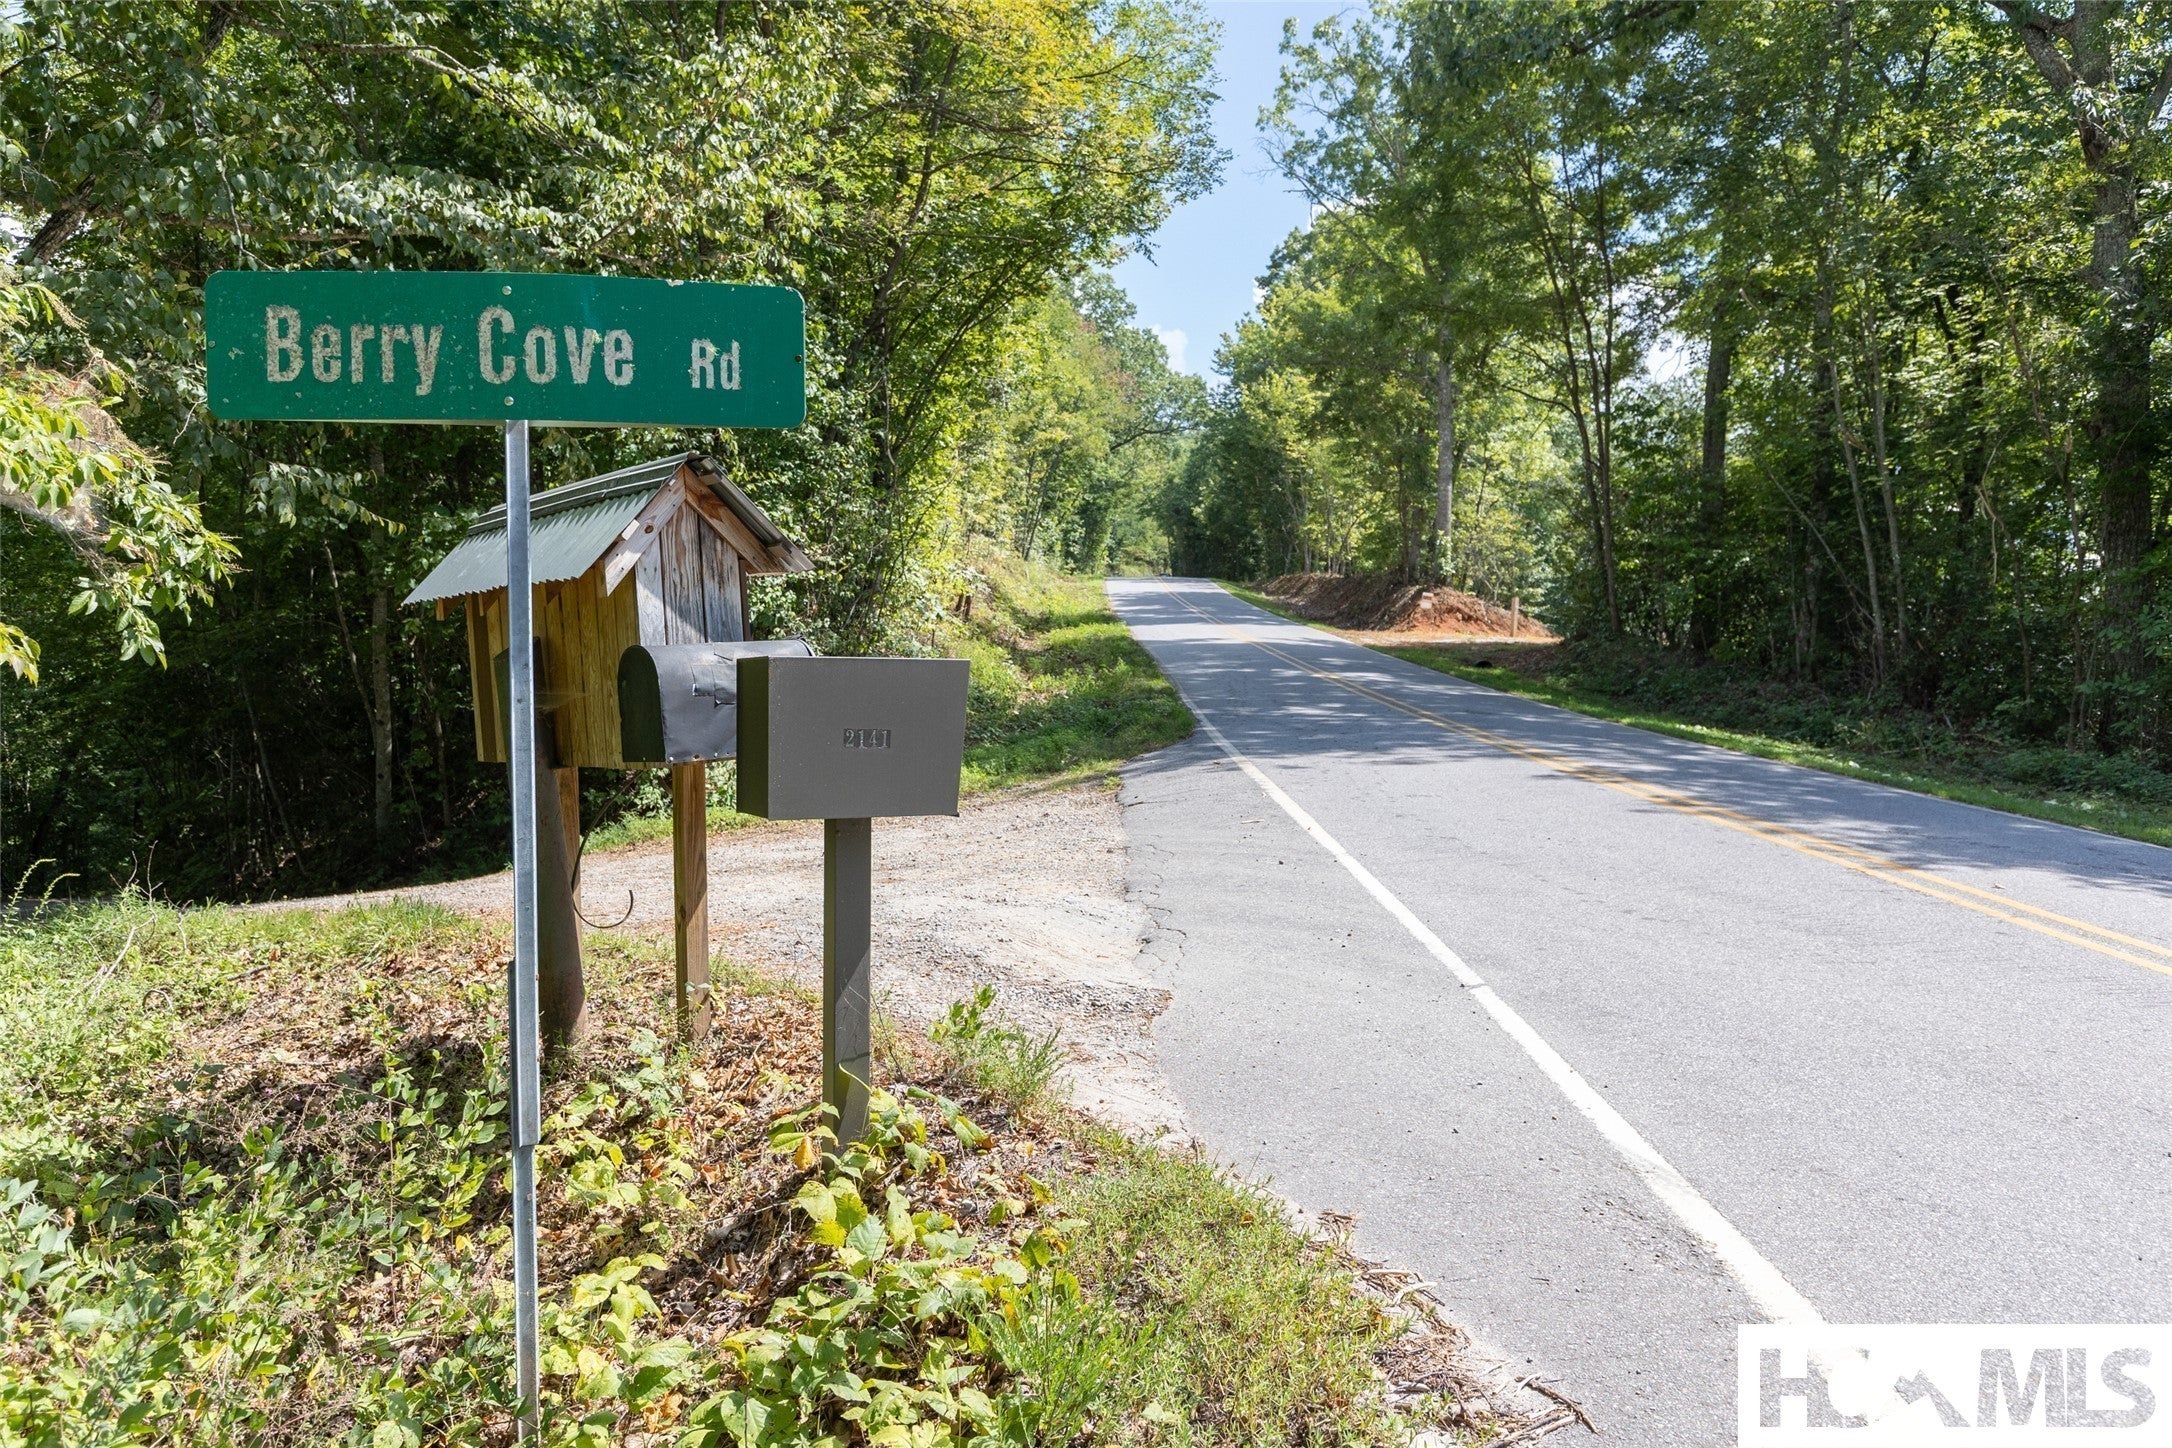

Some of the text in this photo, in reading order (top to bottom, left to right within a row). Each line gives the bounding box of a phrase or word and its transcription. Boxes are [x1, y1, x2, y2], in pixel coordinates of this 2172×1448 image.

[264, 304, 742, 397] Berry Cove Rd
[845, 729, 888, 749] 2141
